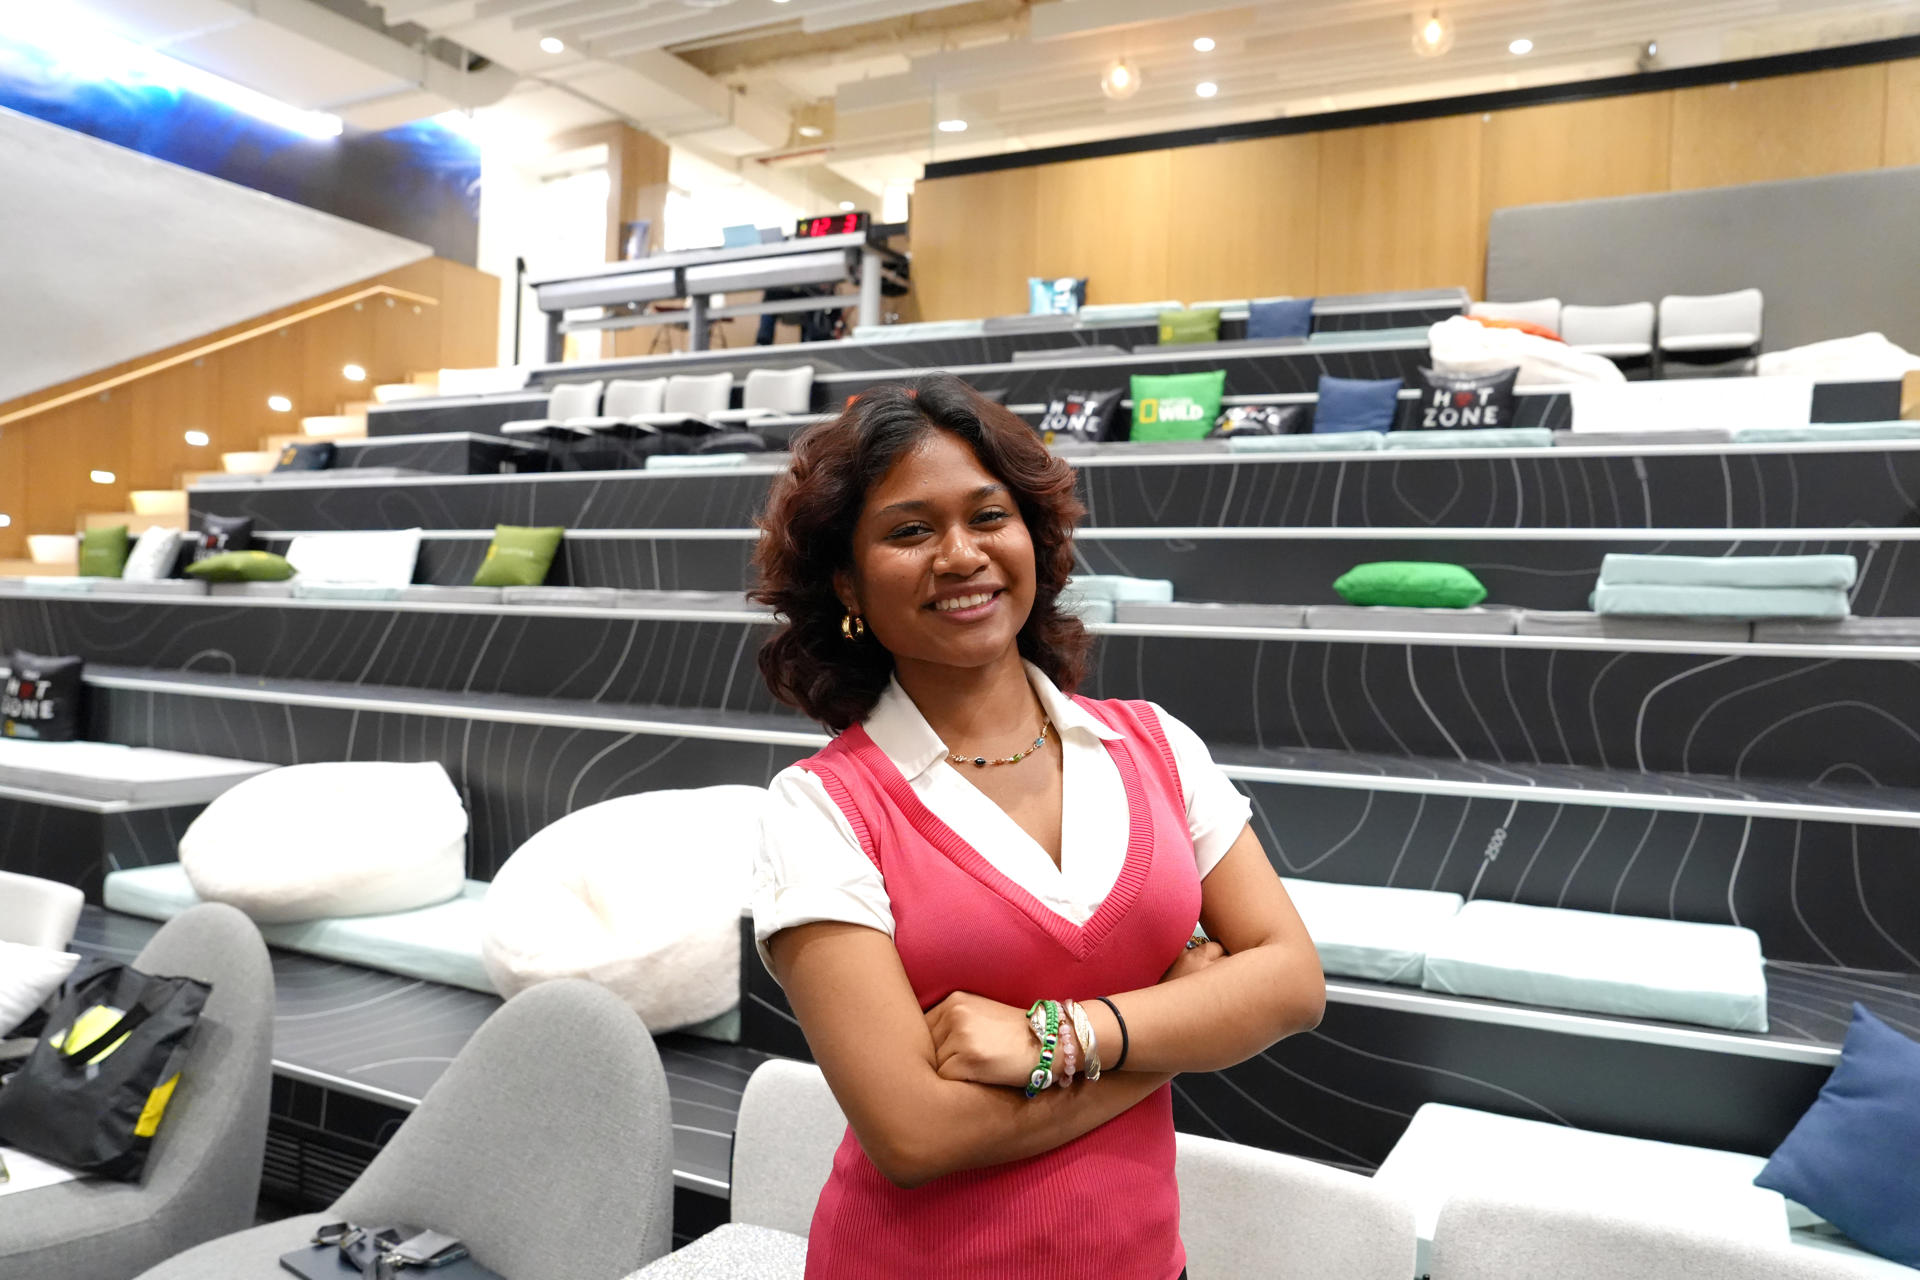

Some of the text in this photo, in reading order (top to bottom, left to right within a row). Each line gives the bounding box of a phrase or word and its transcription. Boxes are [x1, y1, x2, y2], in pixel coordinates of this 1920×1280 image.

[1159, 404, 1204, 422] WILD
[1422, 406, 1499, 428] ZONE
[1039, 414, 1100, 432] ZONE
